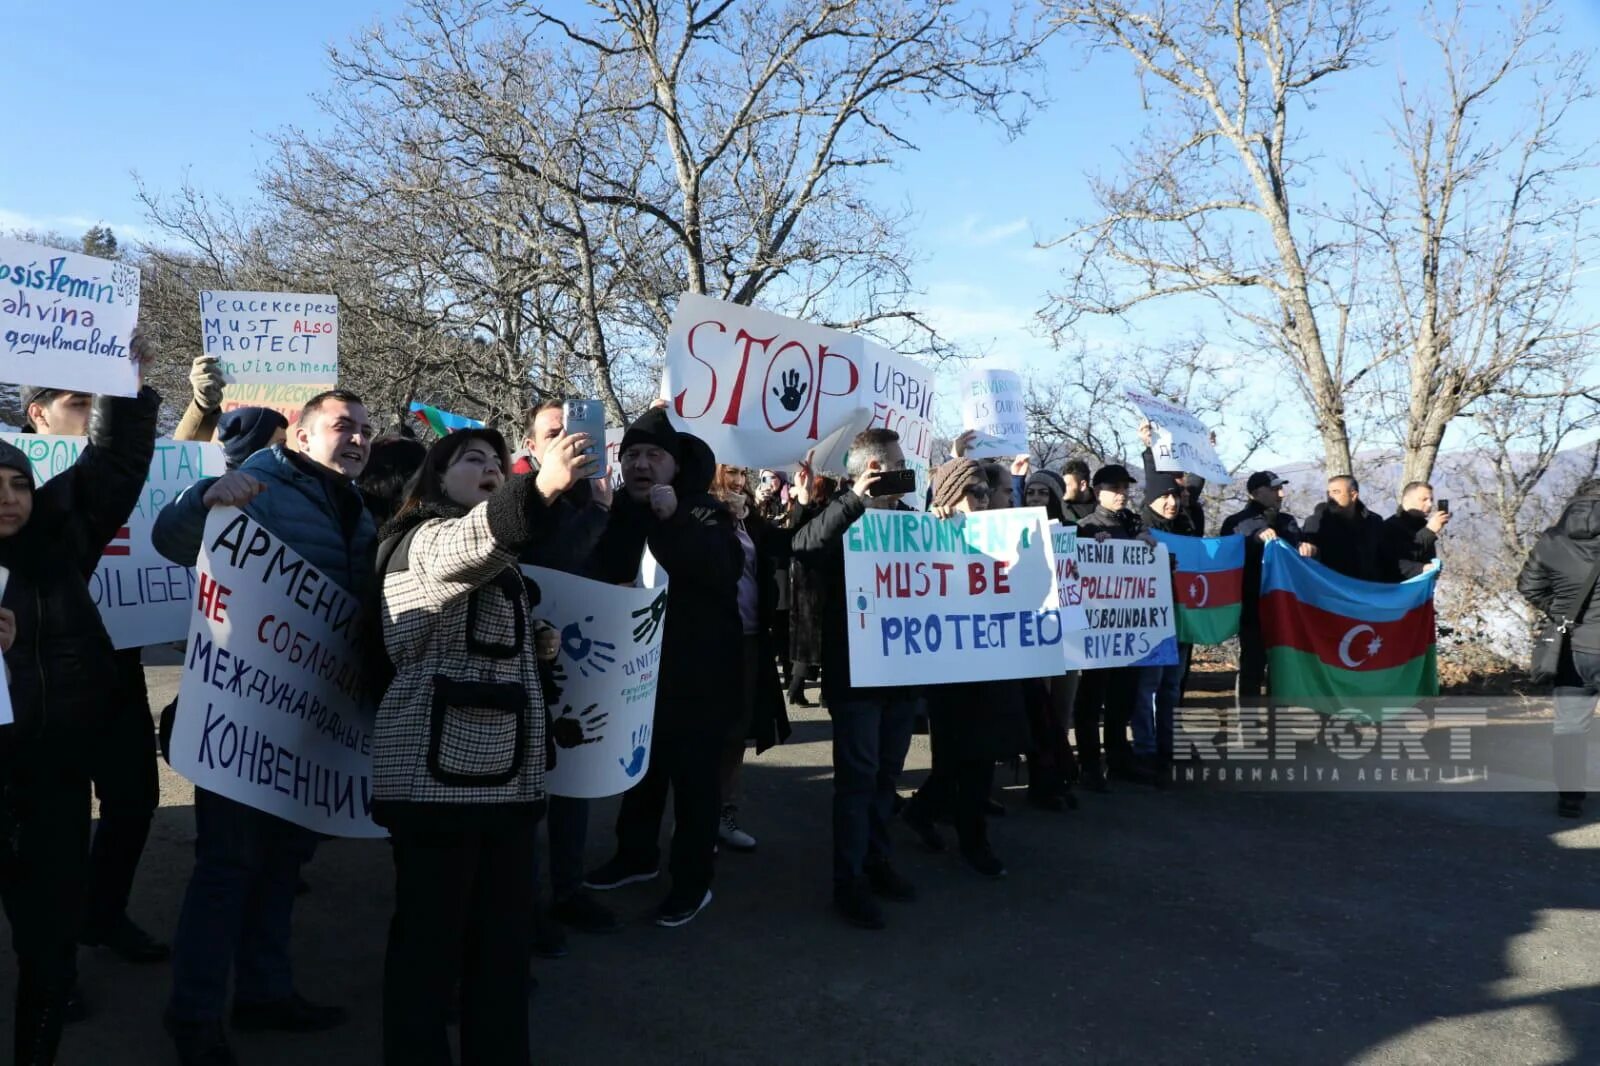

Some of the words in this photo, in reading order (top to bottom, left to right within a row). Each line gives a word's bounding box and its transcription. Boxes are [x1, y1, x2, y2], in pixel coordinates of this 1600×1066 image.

[293, 319, 333, 334] ALSO
[206, 334, 317, 354] PROTECT
[217, 358, 337, 375] nvironment
[674, 320, 859, 440] STOP
[1122, 545, 1156, 565] KEEPS
[875, 562, 954, 598] MUST
[968, 561, 1010, 595] BE
[1081, 576, 1156, 600] POLLUTING
[198, 572, 232, 624] НЕ
[881, 610, 1063, 656] PROTECTED
[1084, 631, 1150, 659] RIVERS
